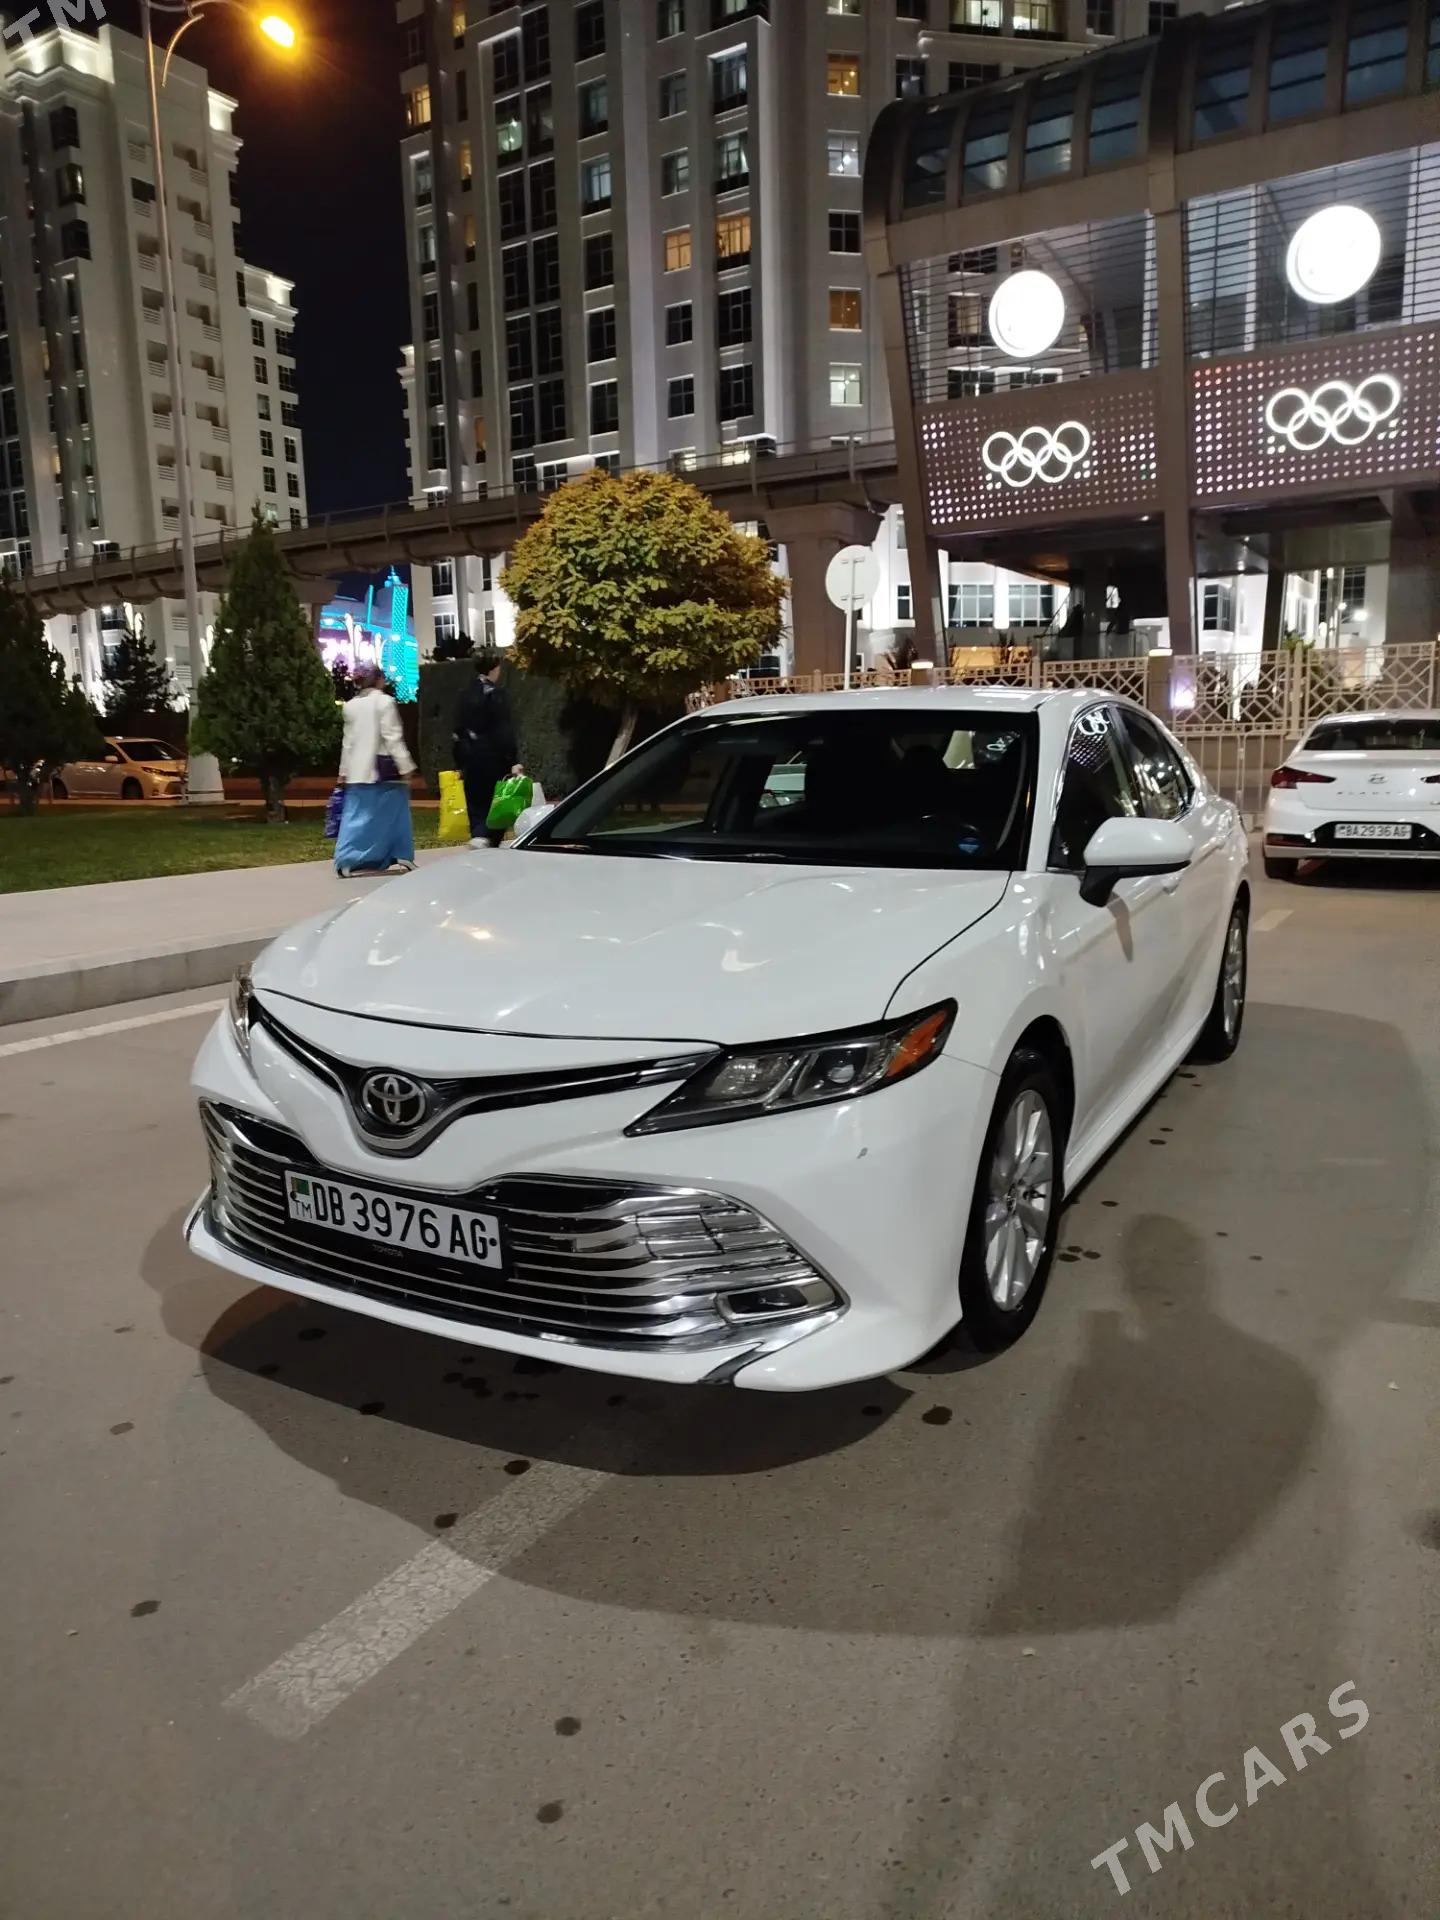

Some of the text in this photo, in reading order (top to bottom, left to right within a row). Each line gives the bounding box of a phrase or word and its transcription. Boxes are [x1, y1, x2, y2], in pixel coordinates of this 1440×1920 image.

[294, 1199, 313, 1219] TM
[312, 1181, 488, 1260] DB 3976 AG
